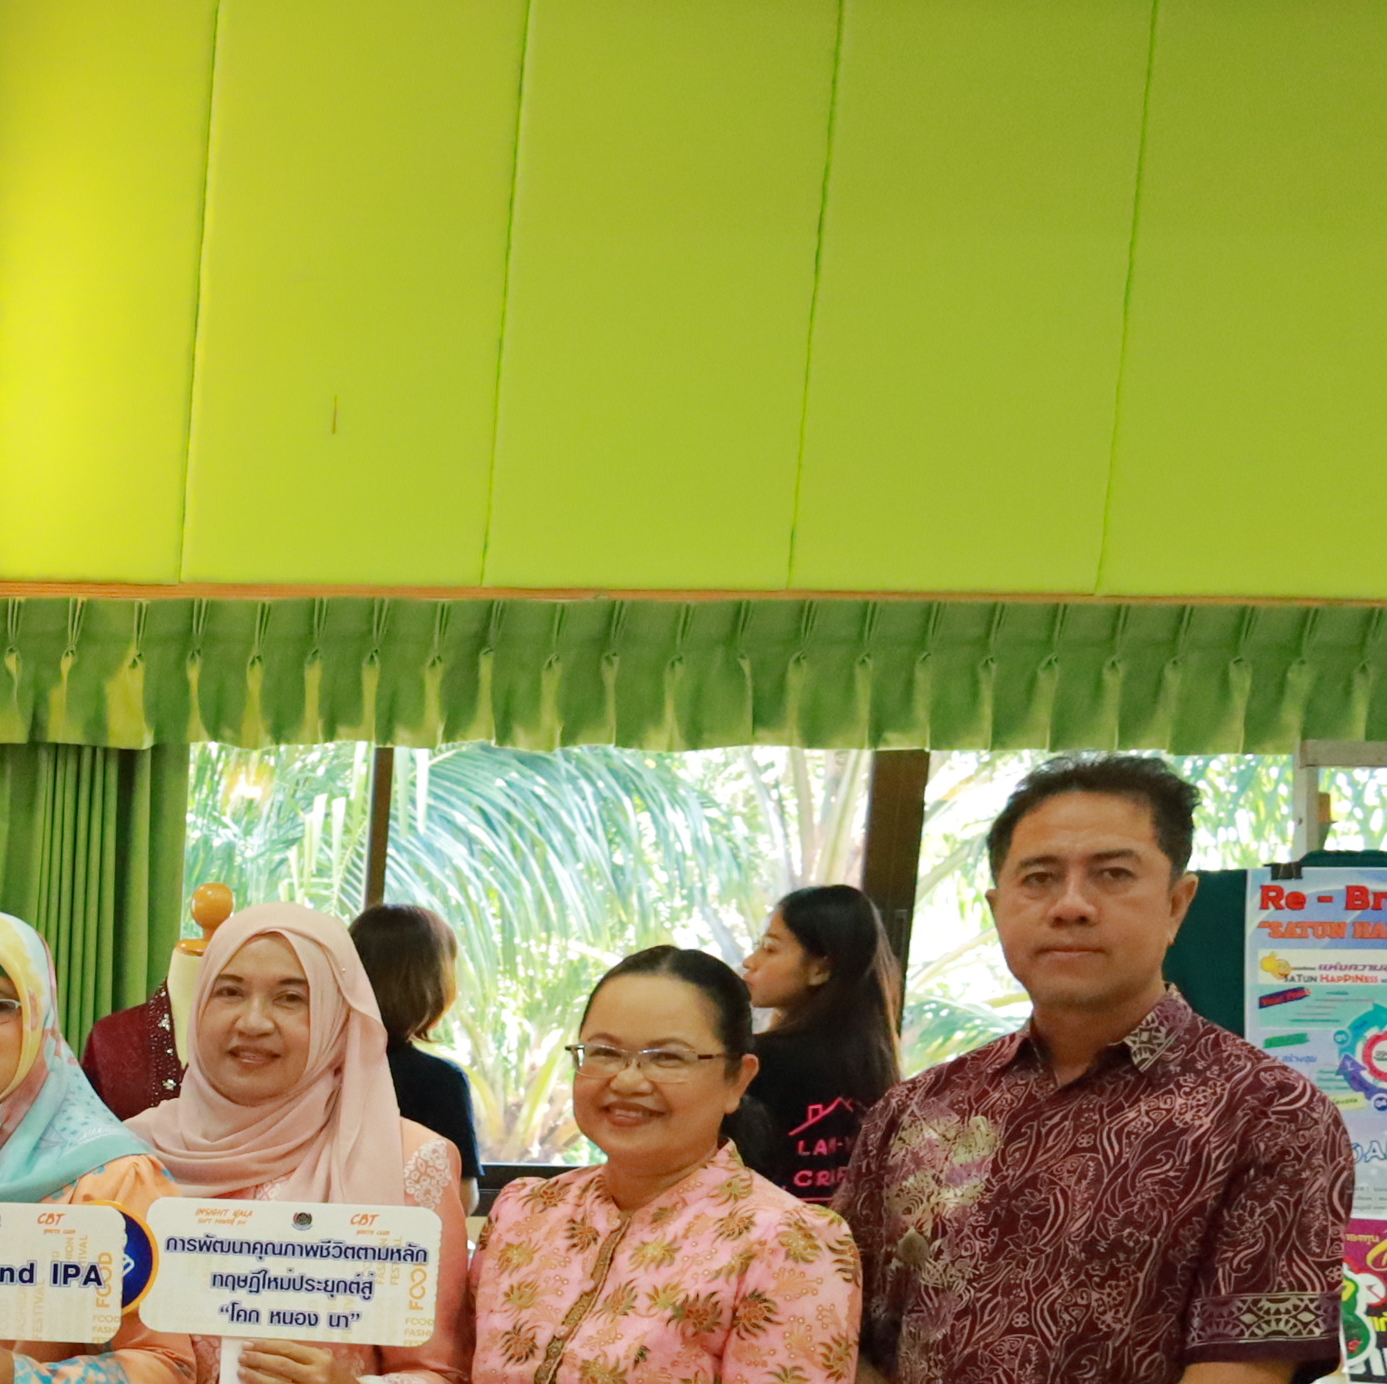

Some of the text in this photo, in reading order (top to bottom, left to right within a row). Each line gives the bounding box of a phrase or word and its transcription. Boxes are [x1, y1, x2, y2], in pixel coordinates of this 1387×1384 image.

[1259, 885, 1307, 911] Re
[37, 1213, 66, 1226] CBT
[350, 1213, 380, 1226] CBT
[165, 1234, 429, 1264] การพัฒนาคุณภาพชีวิตตามหลัก
[50, 1260, 106, 1288] IPA
[211, 1266, 375, 1301] ทฤษฎีใหม่ประยุกต์สู่
[269, 1308, 320, 1328] หนอง
